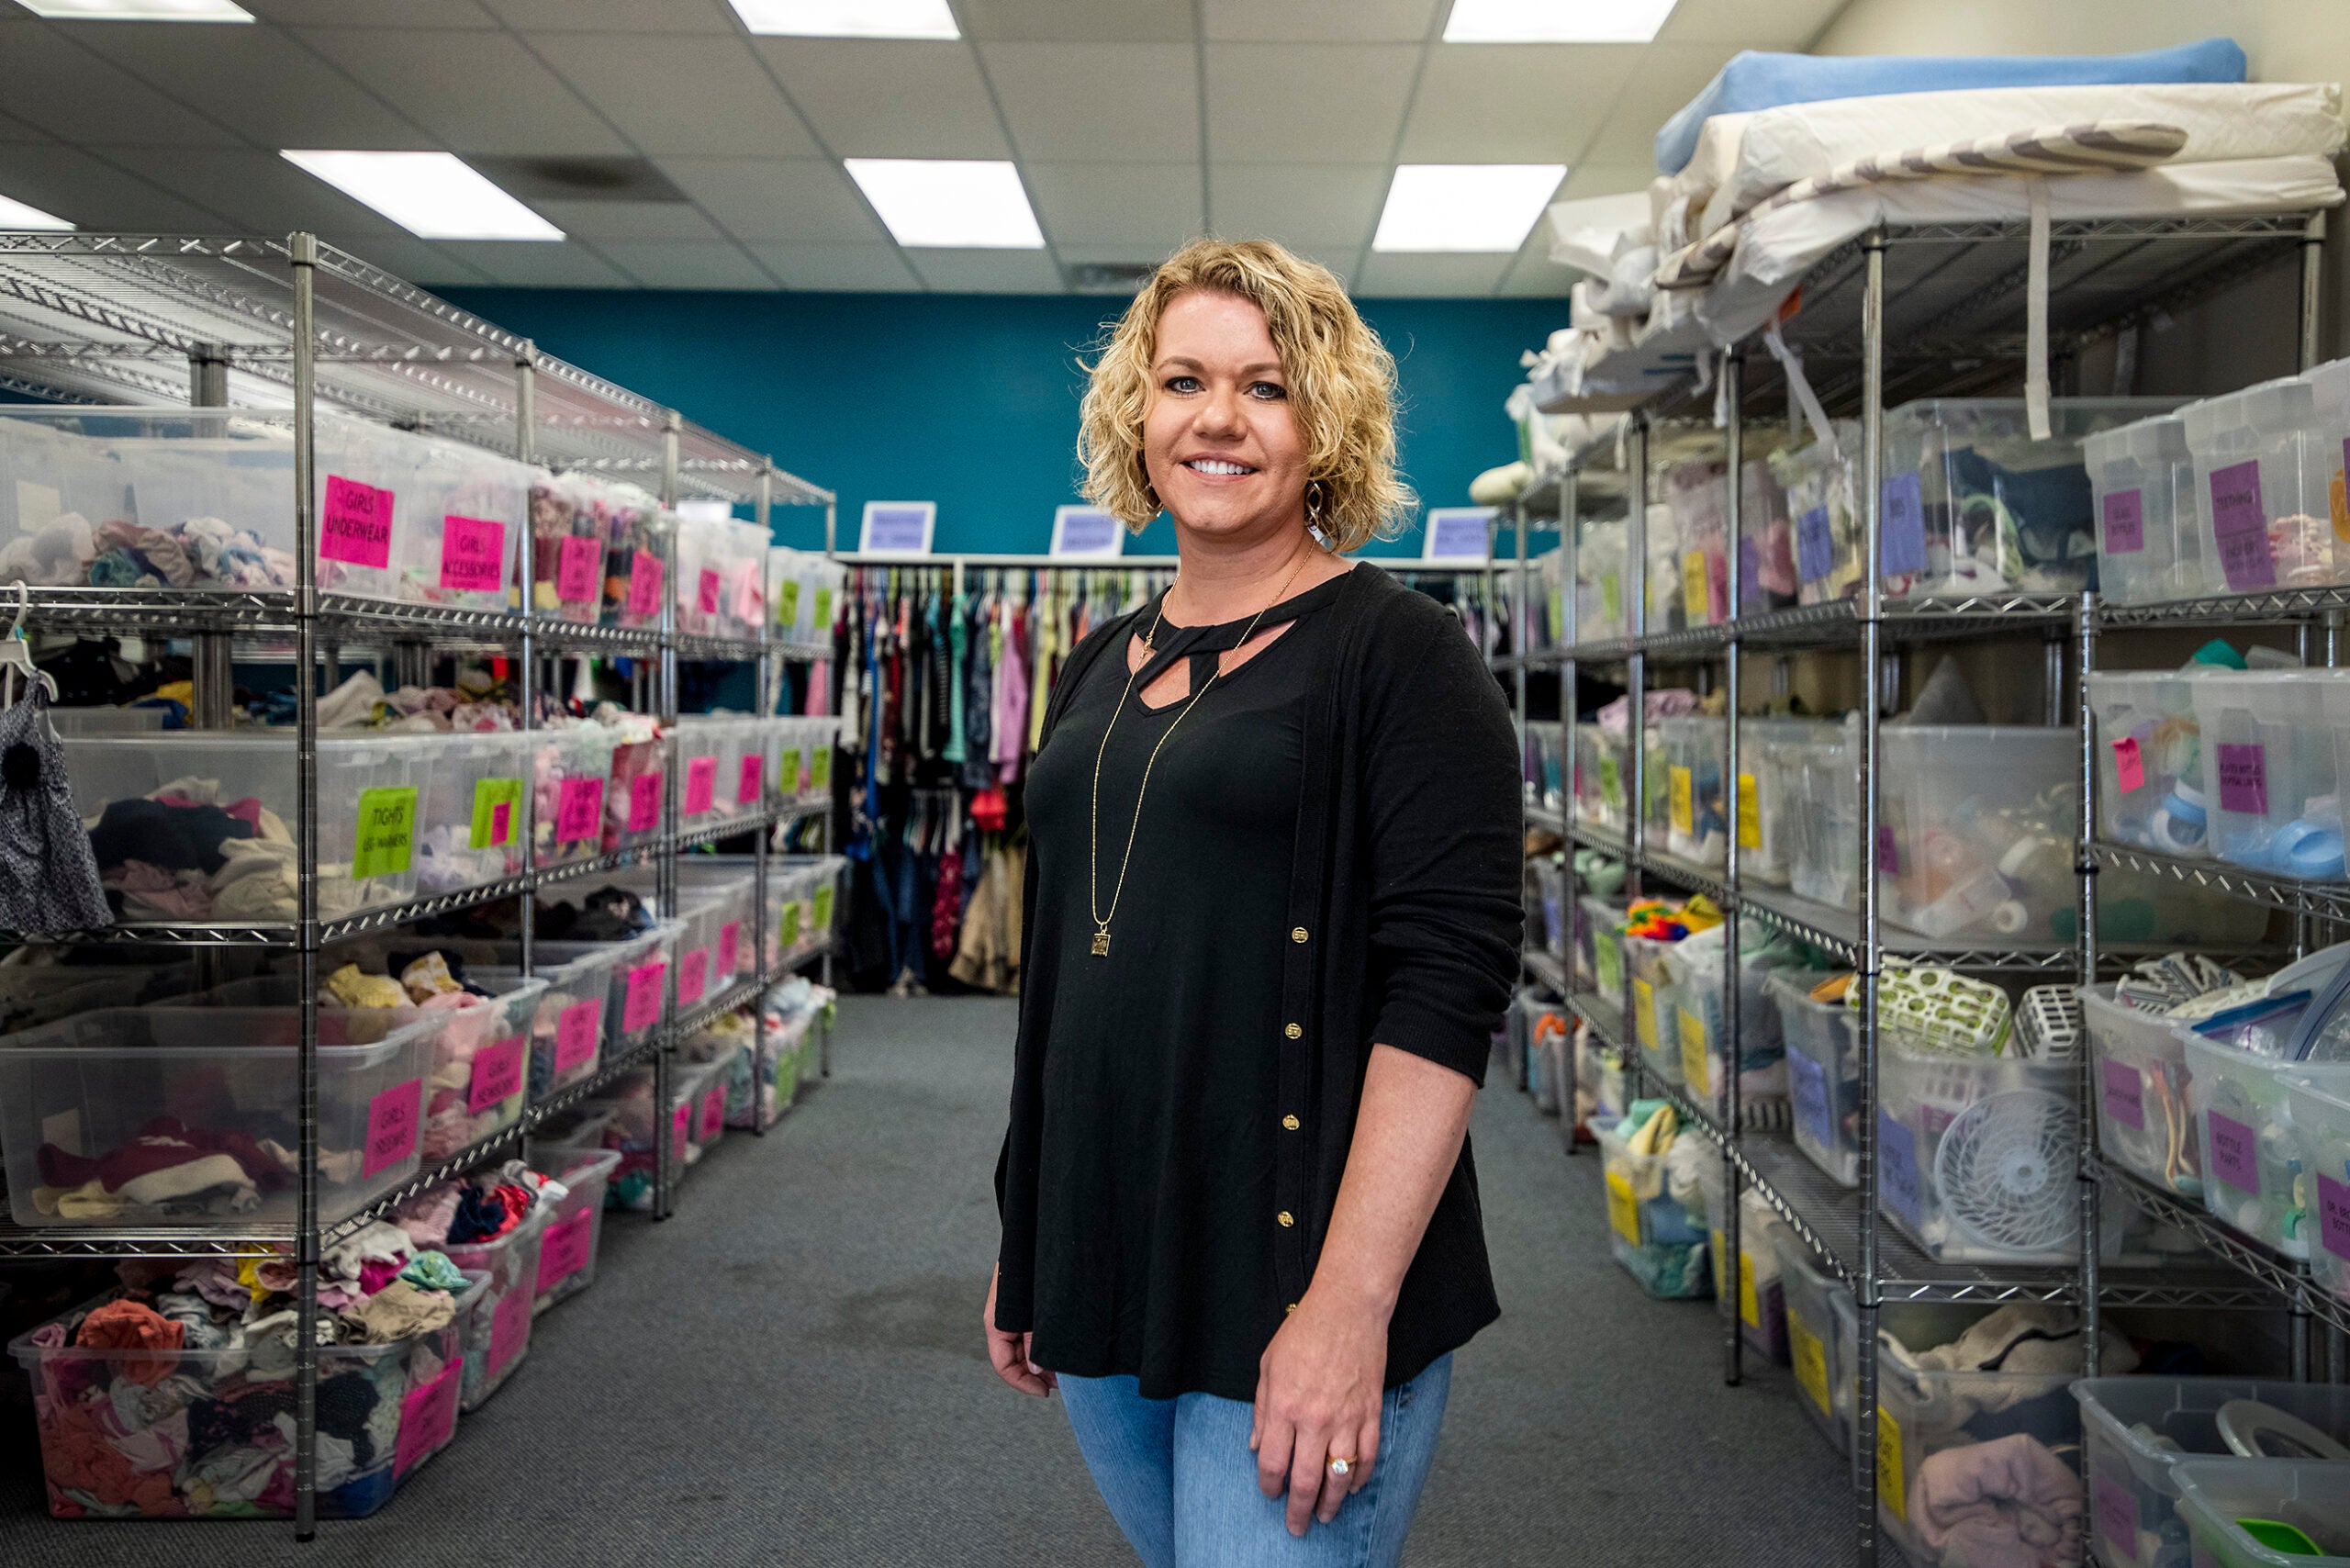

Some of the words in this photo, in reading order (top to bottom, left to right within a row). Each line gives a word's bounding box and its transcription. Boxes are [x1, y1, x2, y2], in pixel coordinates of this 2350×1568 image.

[346, 490, 374, 514] GIRLS
[326, 513, 388, 544] UNDERWEAR
[442, 559, 500, 580] ACCESSORIES
[374, 805, 404, 826] TIGHTS
